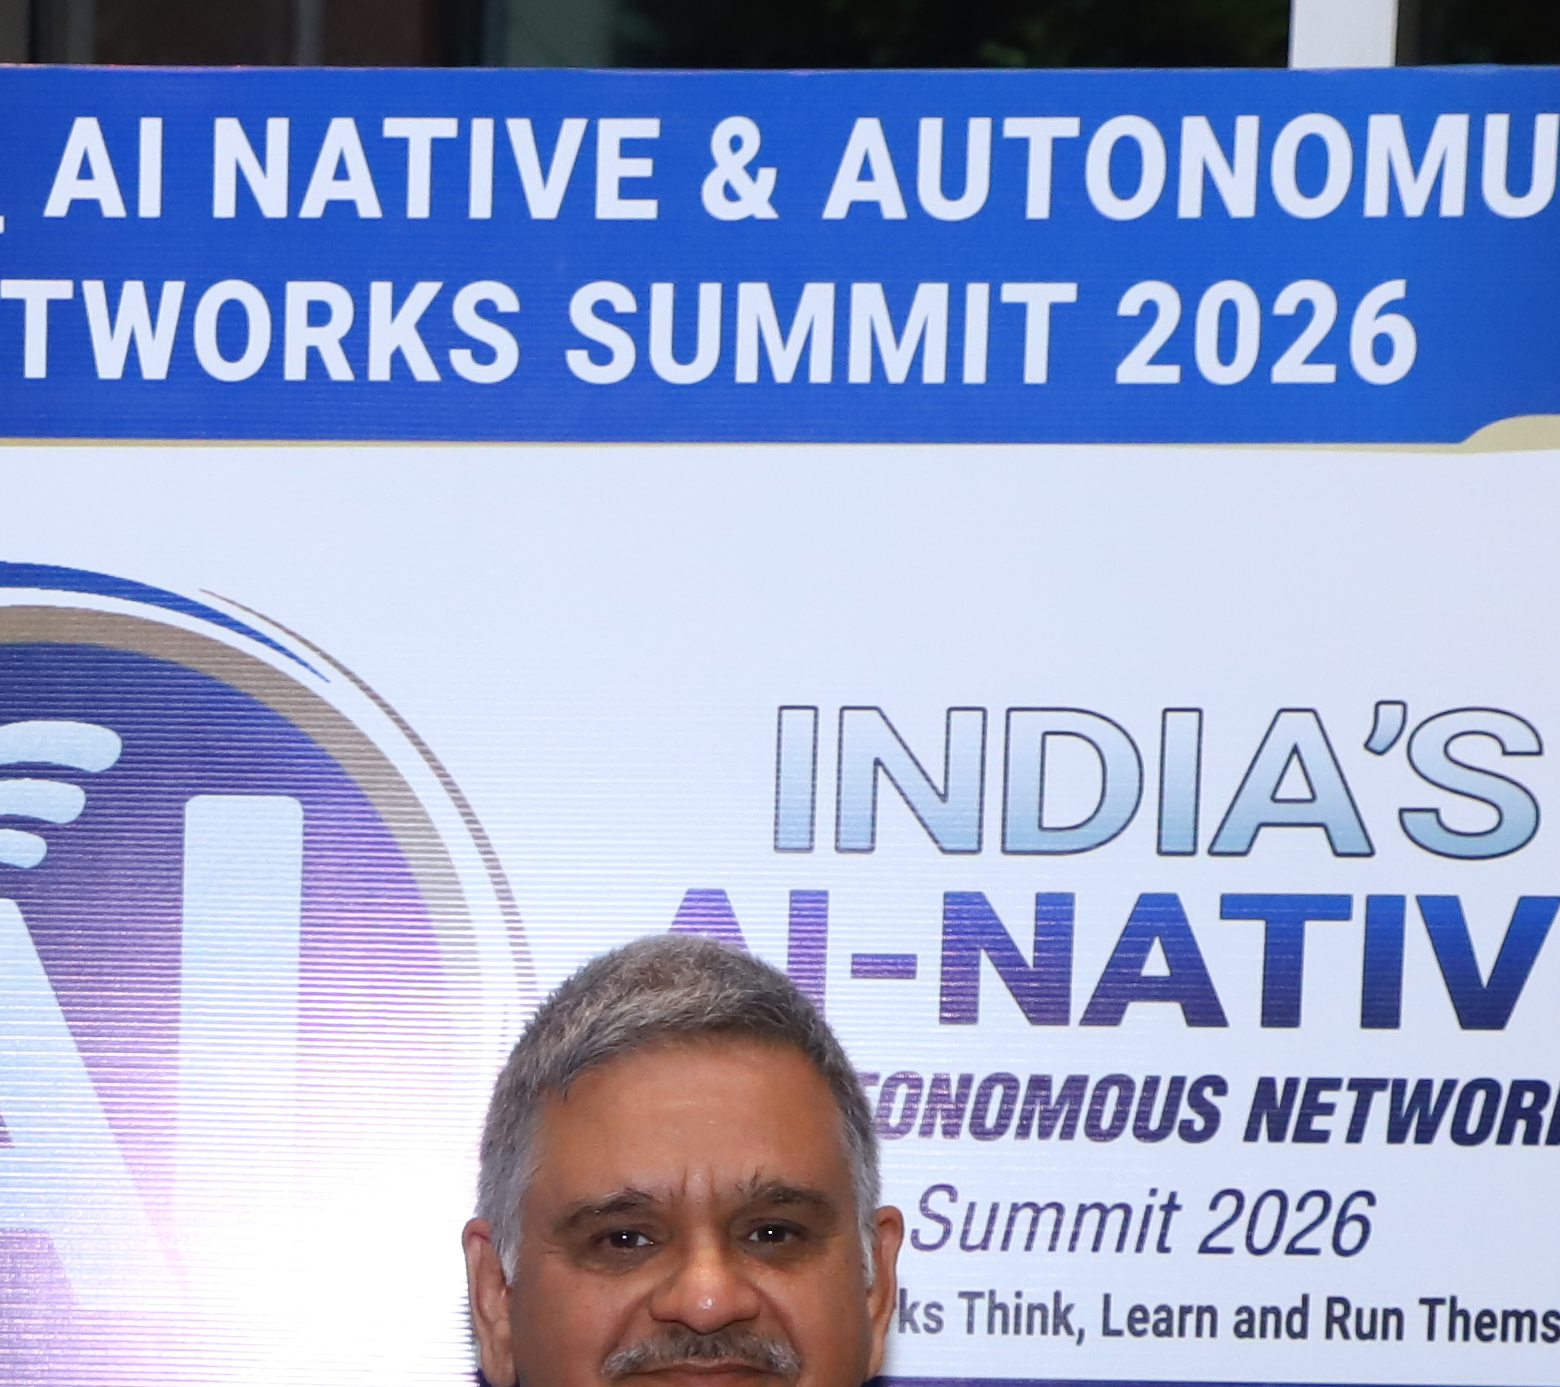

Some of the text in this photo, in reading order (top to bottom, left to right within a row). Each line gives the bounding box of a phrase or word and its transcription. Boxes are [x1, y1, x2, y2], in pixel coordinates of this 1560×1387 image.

[44, 115, 163, 220] AI
[212, 114, 659, 222] NATIVE
[702, 115, 779, 221] &
[565, 279, 1077, 386] SUMMIT
[1115, 277, 1419, 386] 2026
[772, 700, 1546, 860] INDIA'S
[910, 1184, 1377, 1258] Summit 2026
[958, 1289, 1086, 1346] Think,
[1101, 1292, 1219, 1340] Learn
[1234, 1291, 1308, 1342] and
[1325, 1295, 1405, 1344] Run
